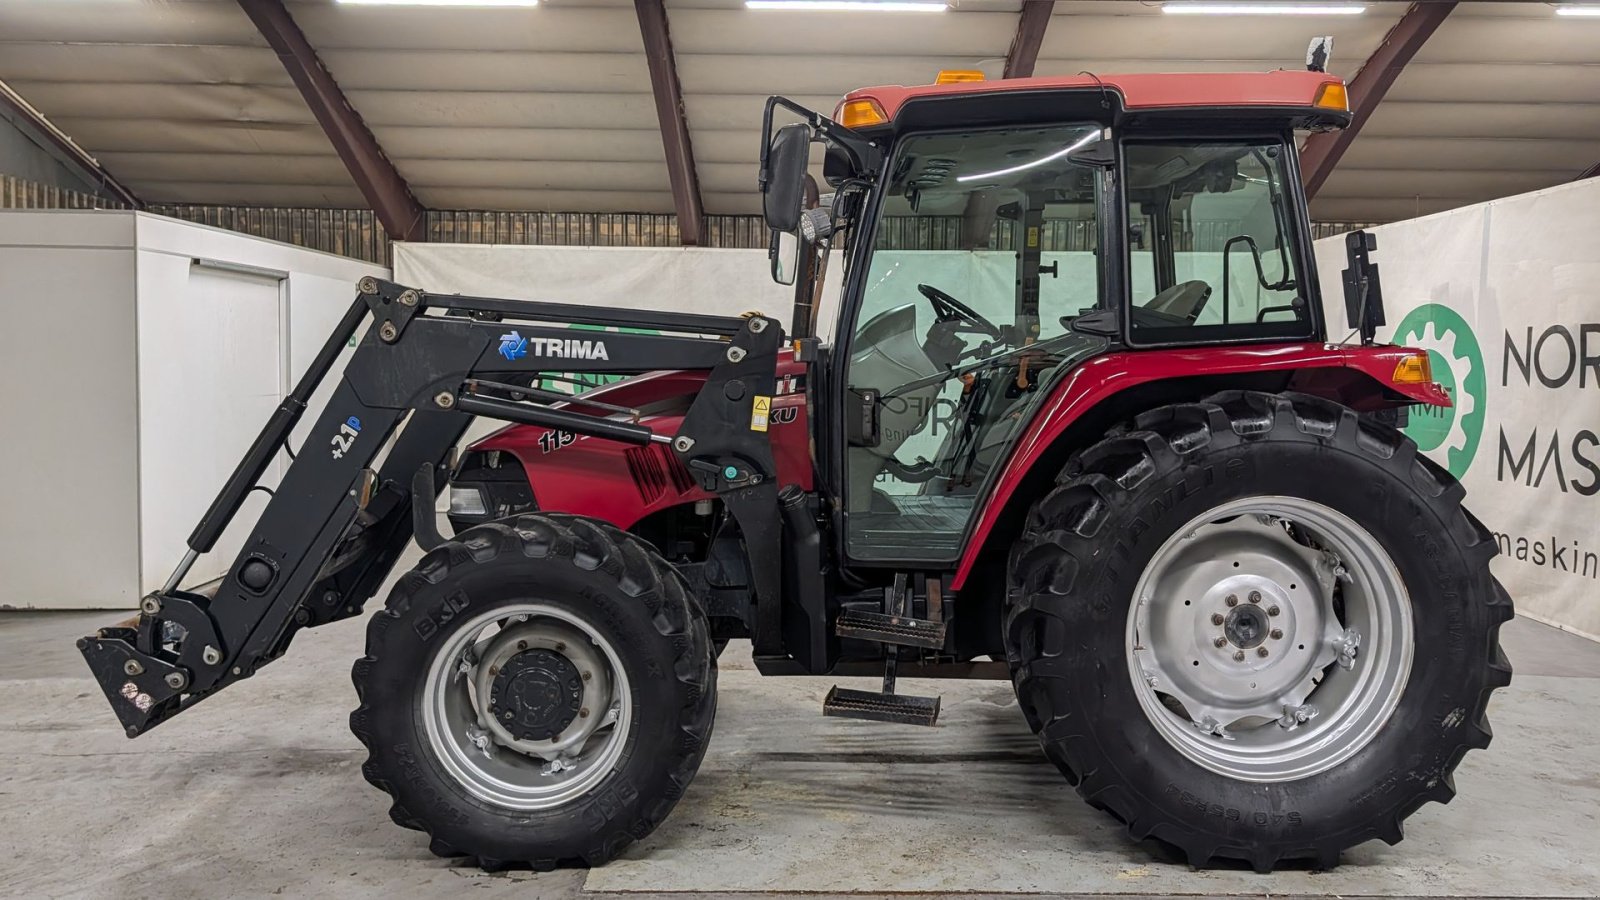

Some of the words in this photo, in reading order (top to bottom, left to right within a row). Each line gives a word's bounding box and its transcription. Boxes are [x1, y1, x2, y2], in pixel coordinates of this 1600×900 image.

[531, 337, 609, 361] TRIMA
[1502, 323, 1600, 389] NOR
[538, 429, 577, 454] 115
[1497, 422, 1600, 496] MAS
[413, 588, 471, 641] BKT
